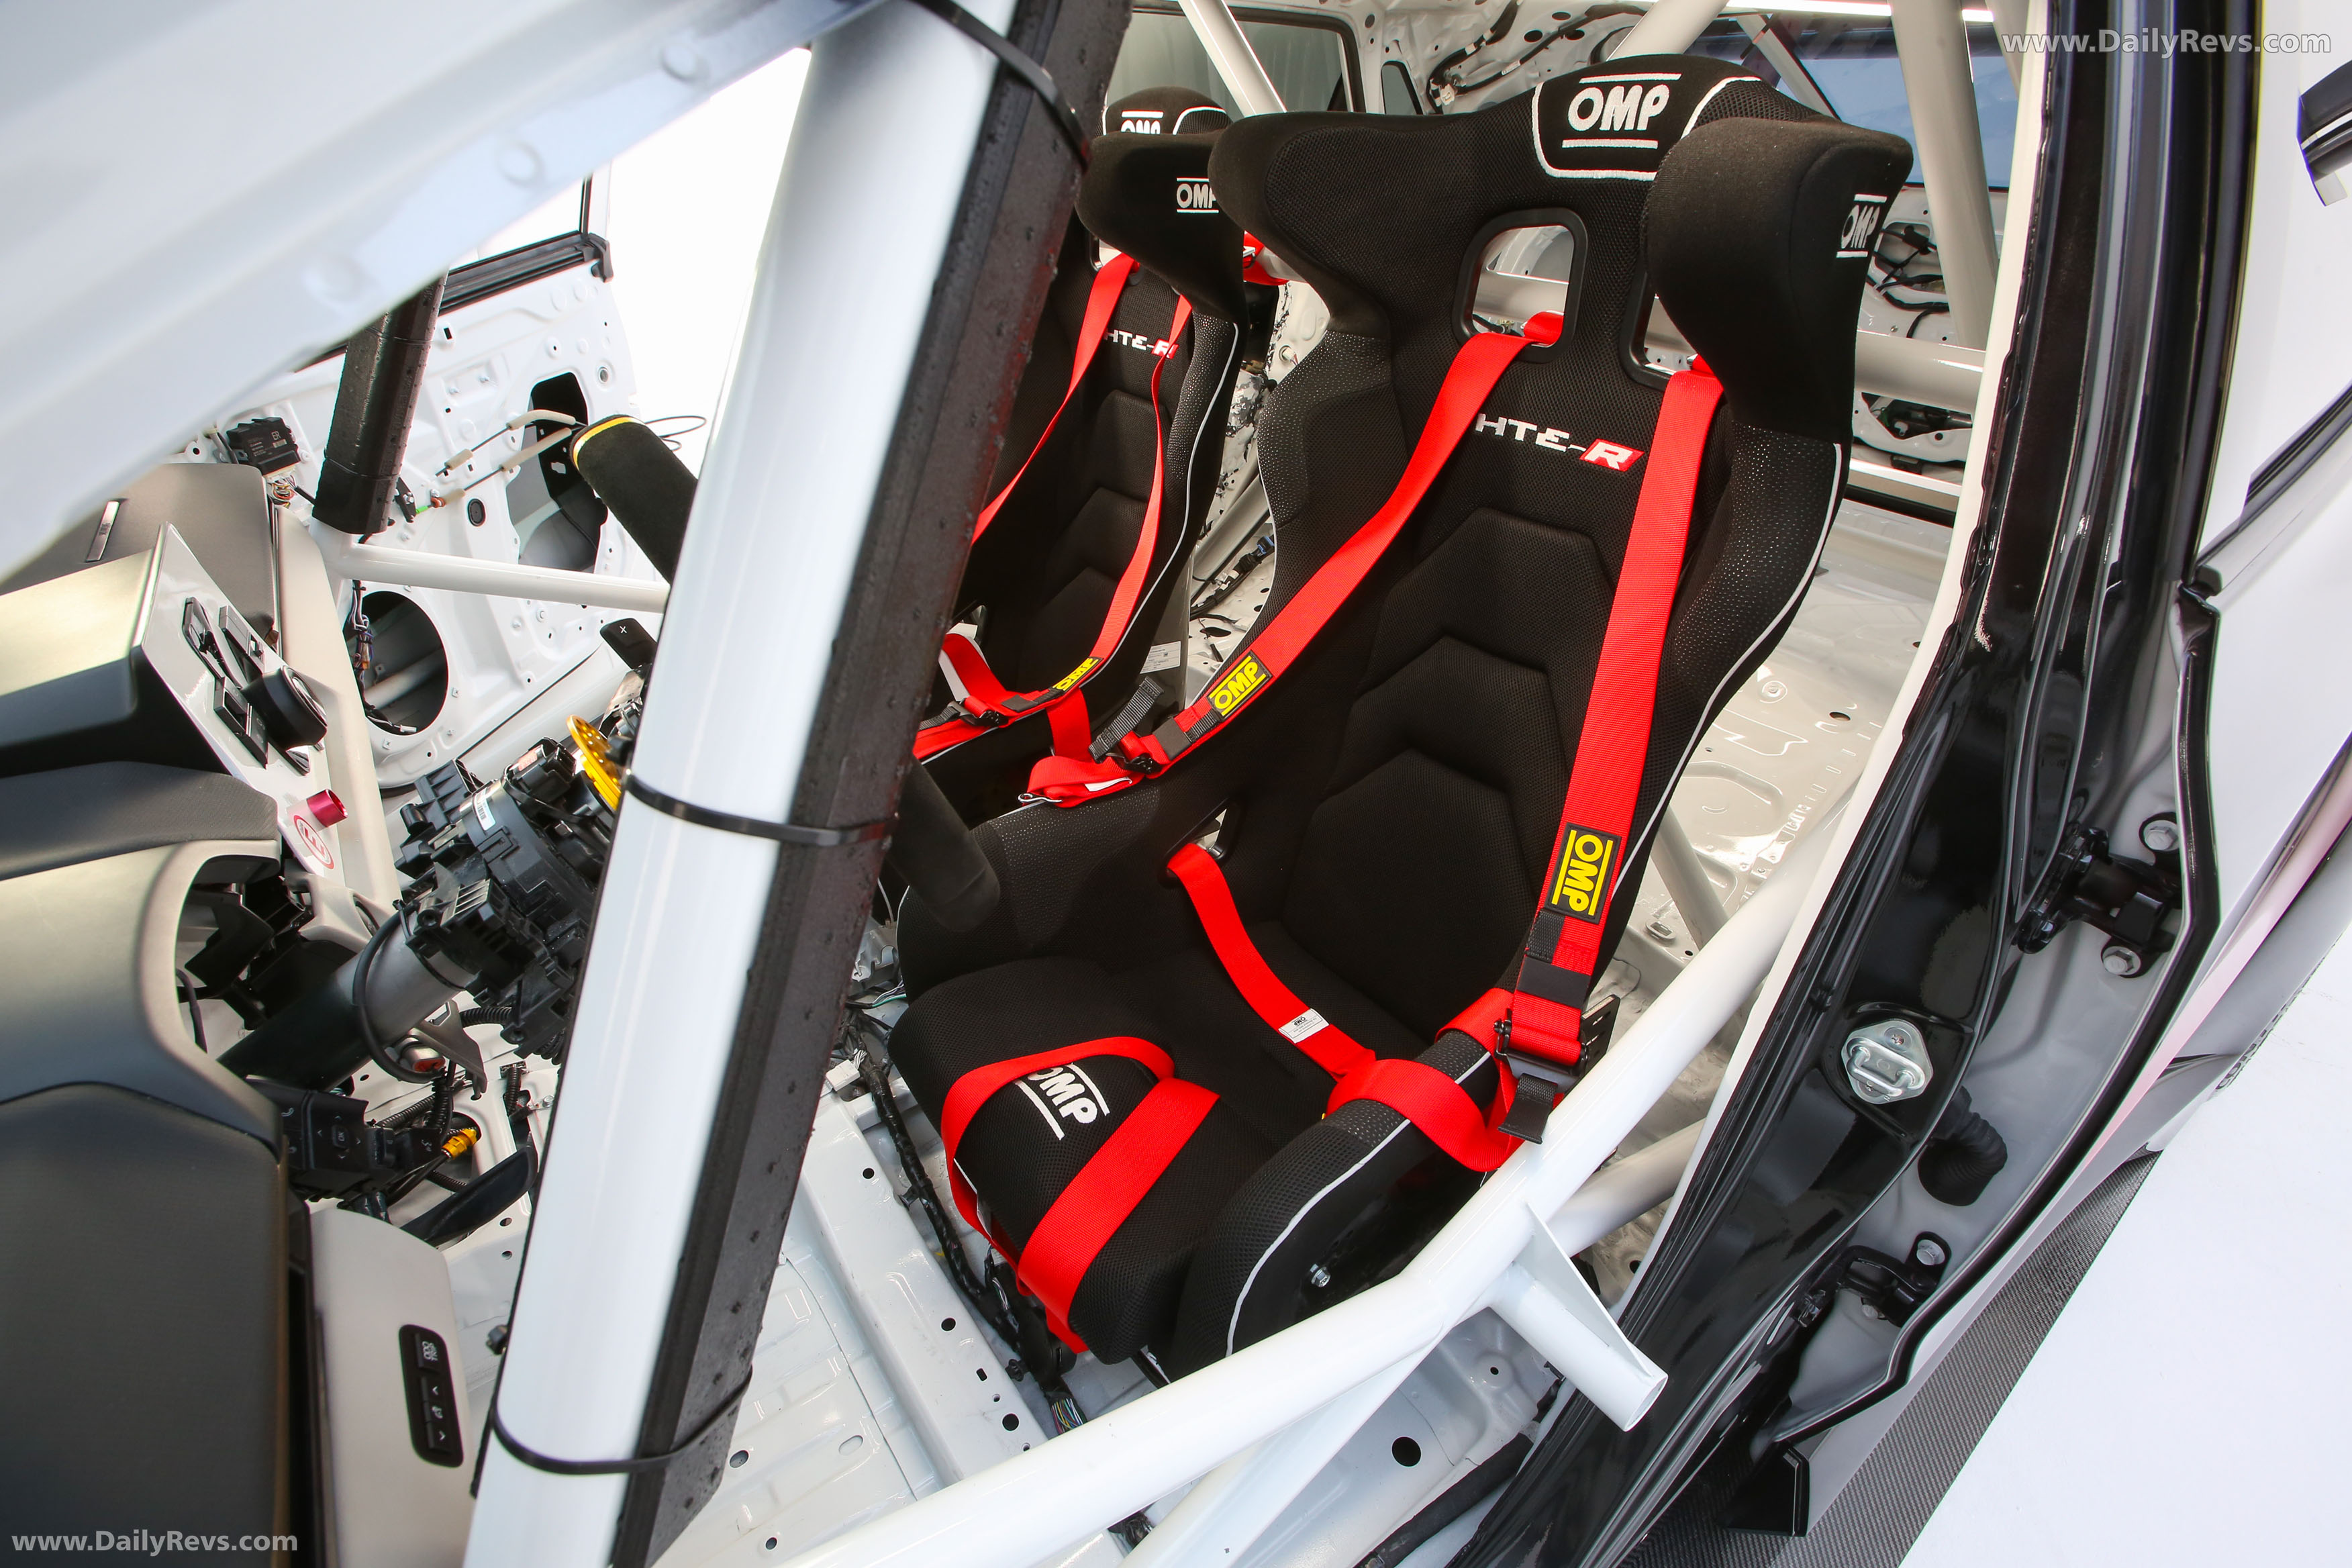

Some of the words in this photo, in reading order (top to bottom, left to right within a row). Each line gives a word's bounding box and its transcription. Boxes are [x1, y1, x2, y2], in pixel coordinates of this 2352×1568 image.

[1568, 84, 1670, 131] OMP
[1841, 205, 1879, 248] OMP
[1214, 662, 1259, 709] OMP
[1561, 834, 1604, 912] OMP
[1293, 1016, 1306, 1026] OMP
